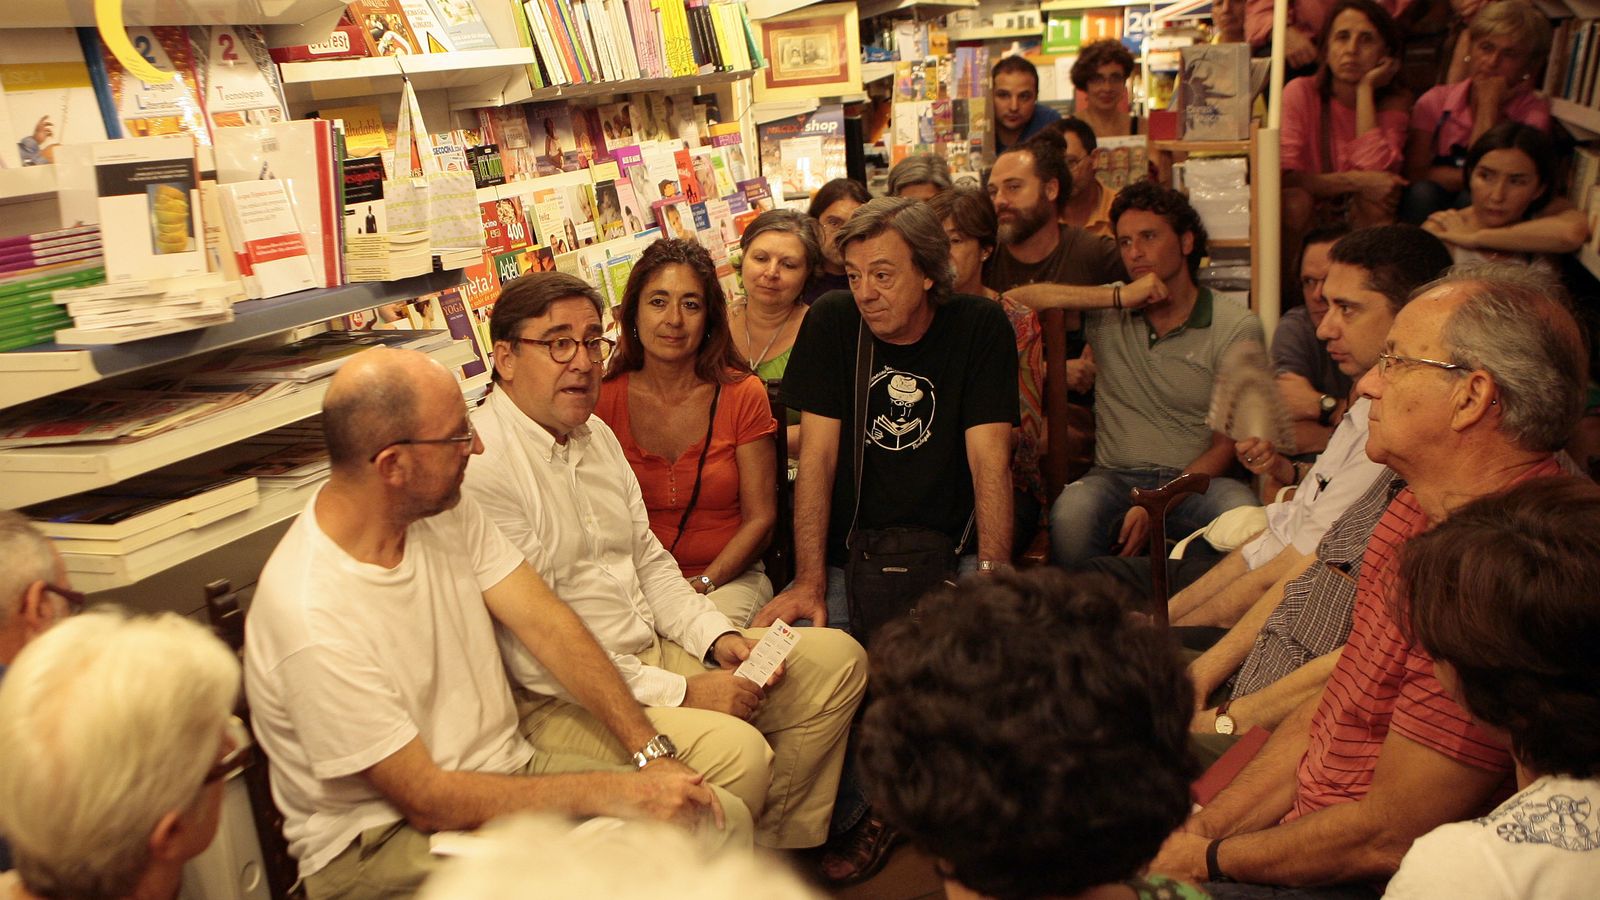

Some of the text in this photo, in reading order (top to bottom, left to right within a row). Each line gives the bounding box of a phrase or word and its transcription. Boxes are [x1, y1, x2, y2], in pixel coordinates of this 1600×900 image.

[135, 36, 156, 63] 2
[219, 34, 239, 61] 2
[804, 119, 838, 134] shop
[507, 221, 525, 241] 400
[443, 302, 465, 316] YOGA
